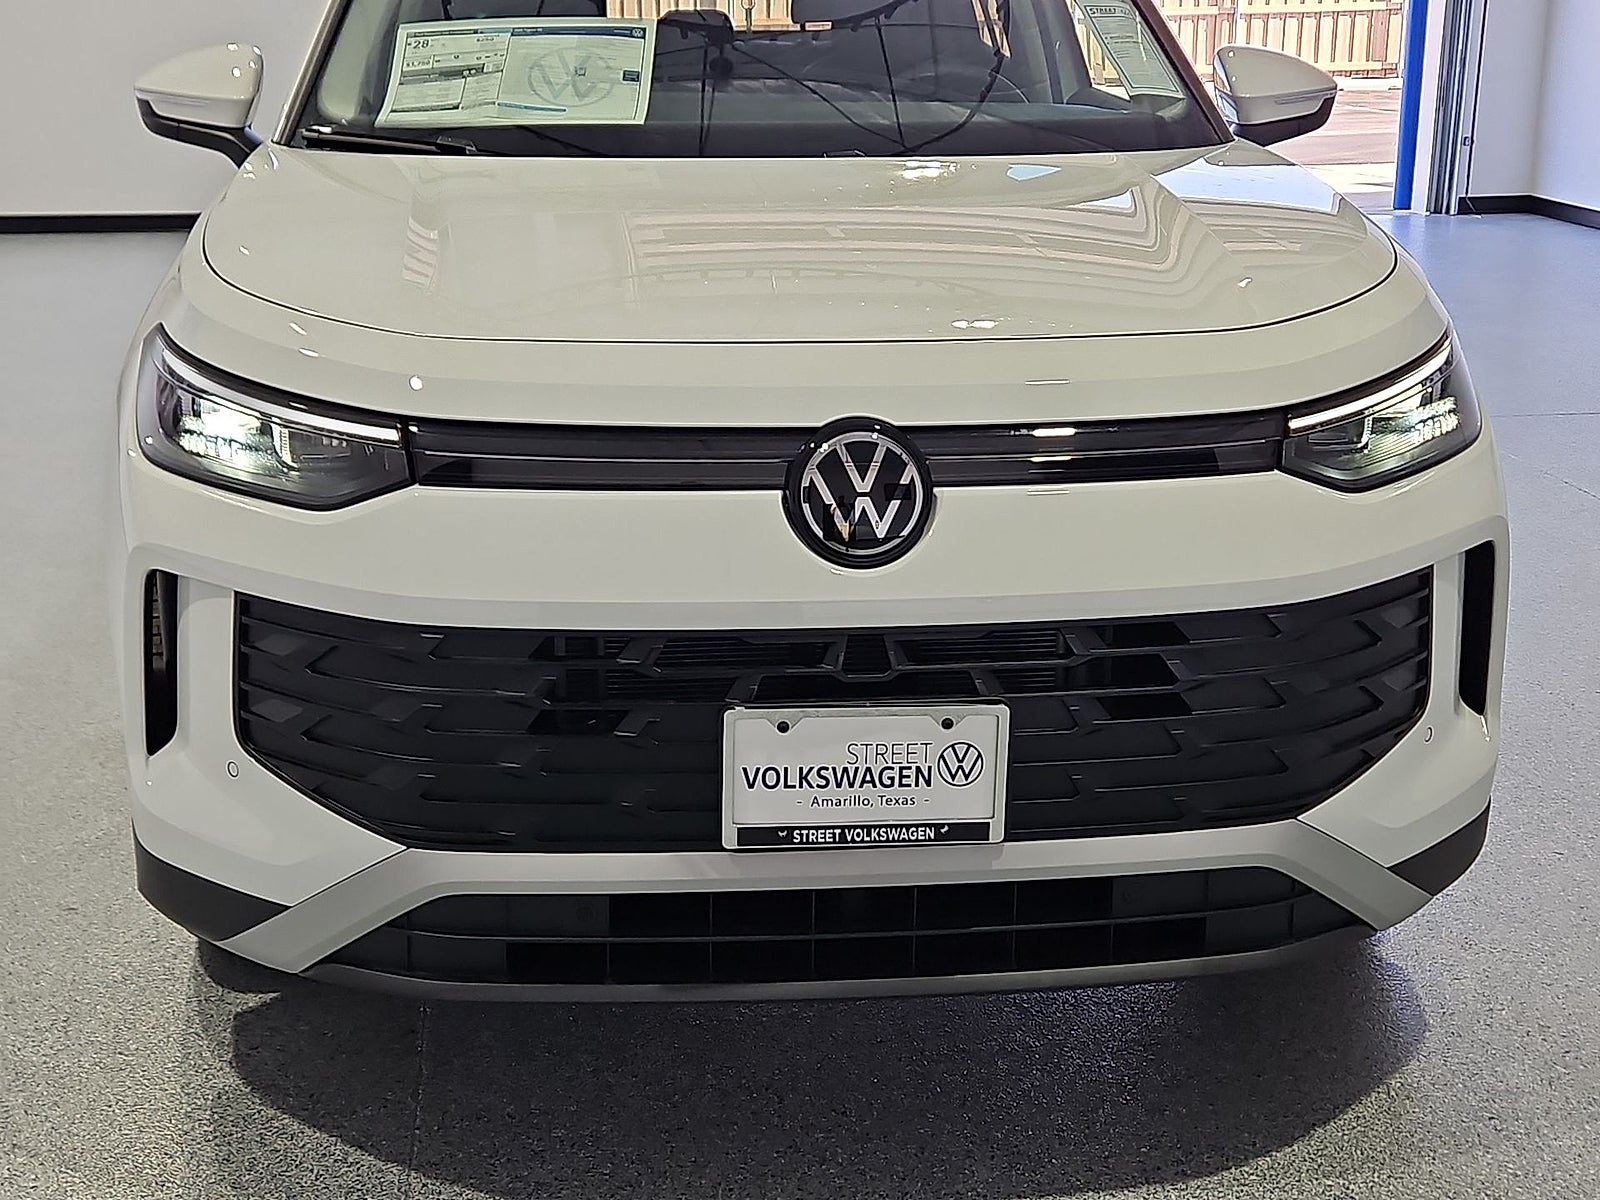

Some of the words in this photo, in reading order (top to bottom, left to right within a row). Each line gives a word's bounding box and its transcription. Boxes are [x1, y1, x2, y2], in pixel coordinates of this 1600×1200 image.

[412, 39, 430, 49] 28
[846, 742, 933, 766] STREET
[741, 765, 933, 790] VOLKSWAGEN
[810, 794, 875, 809] Amarillo,
[878, 795, 917, 808] Texas
[792, 828, 842, 843] STREET
[844, 827, 935, 842] VOLKSWAGEN
